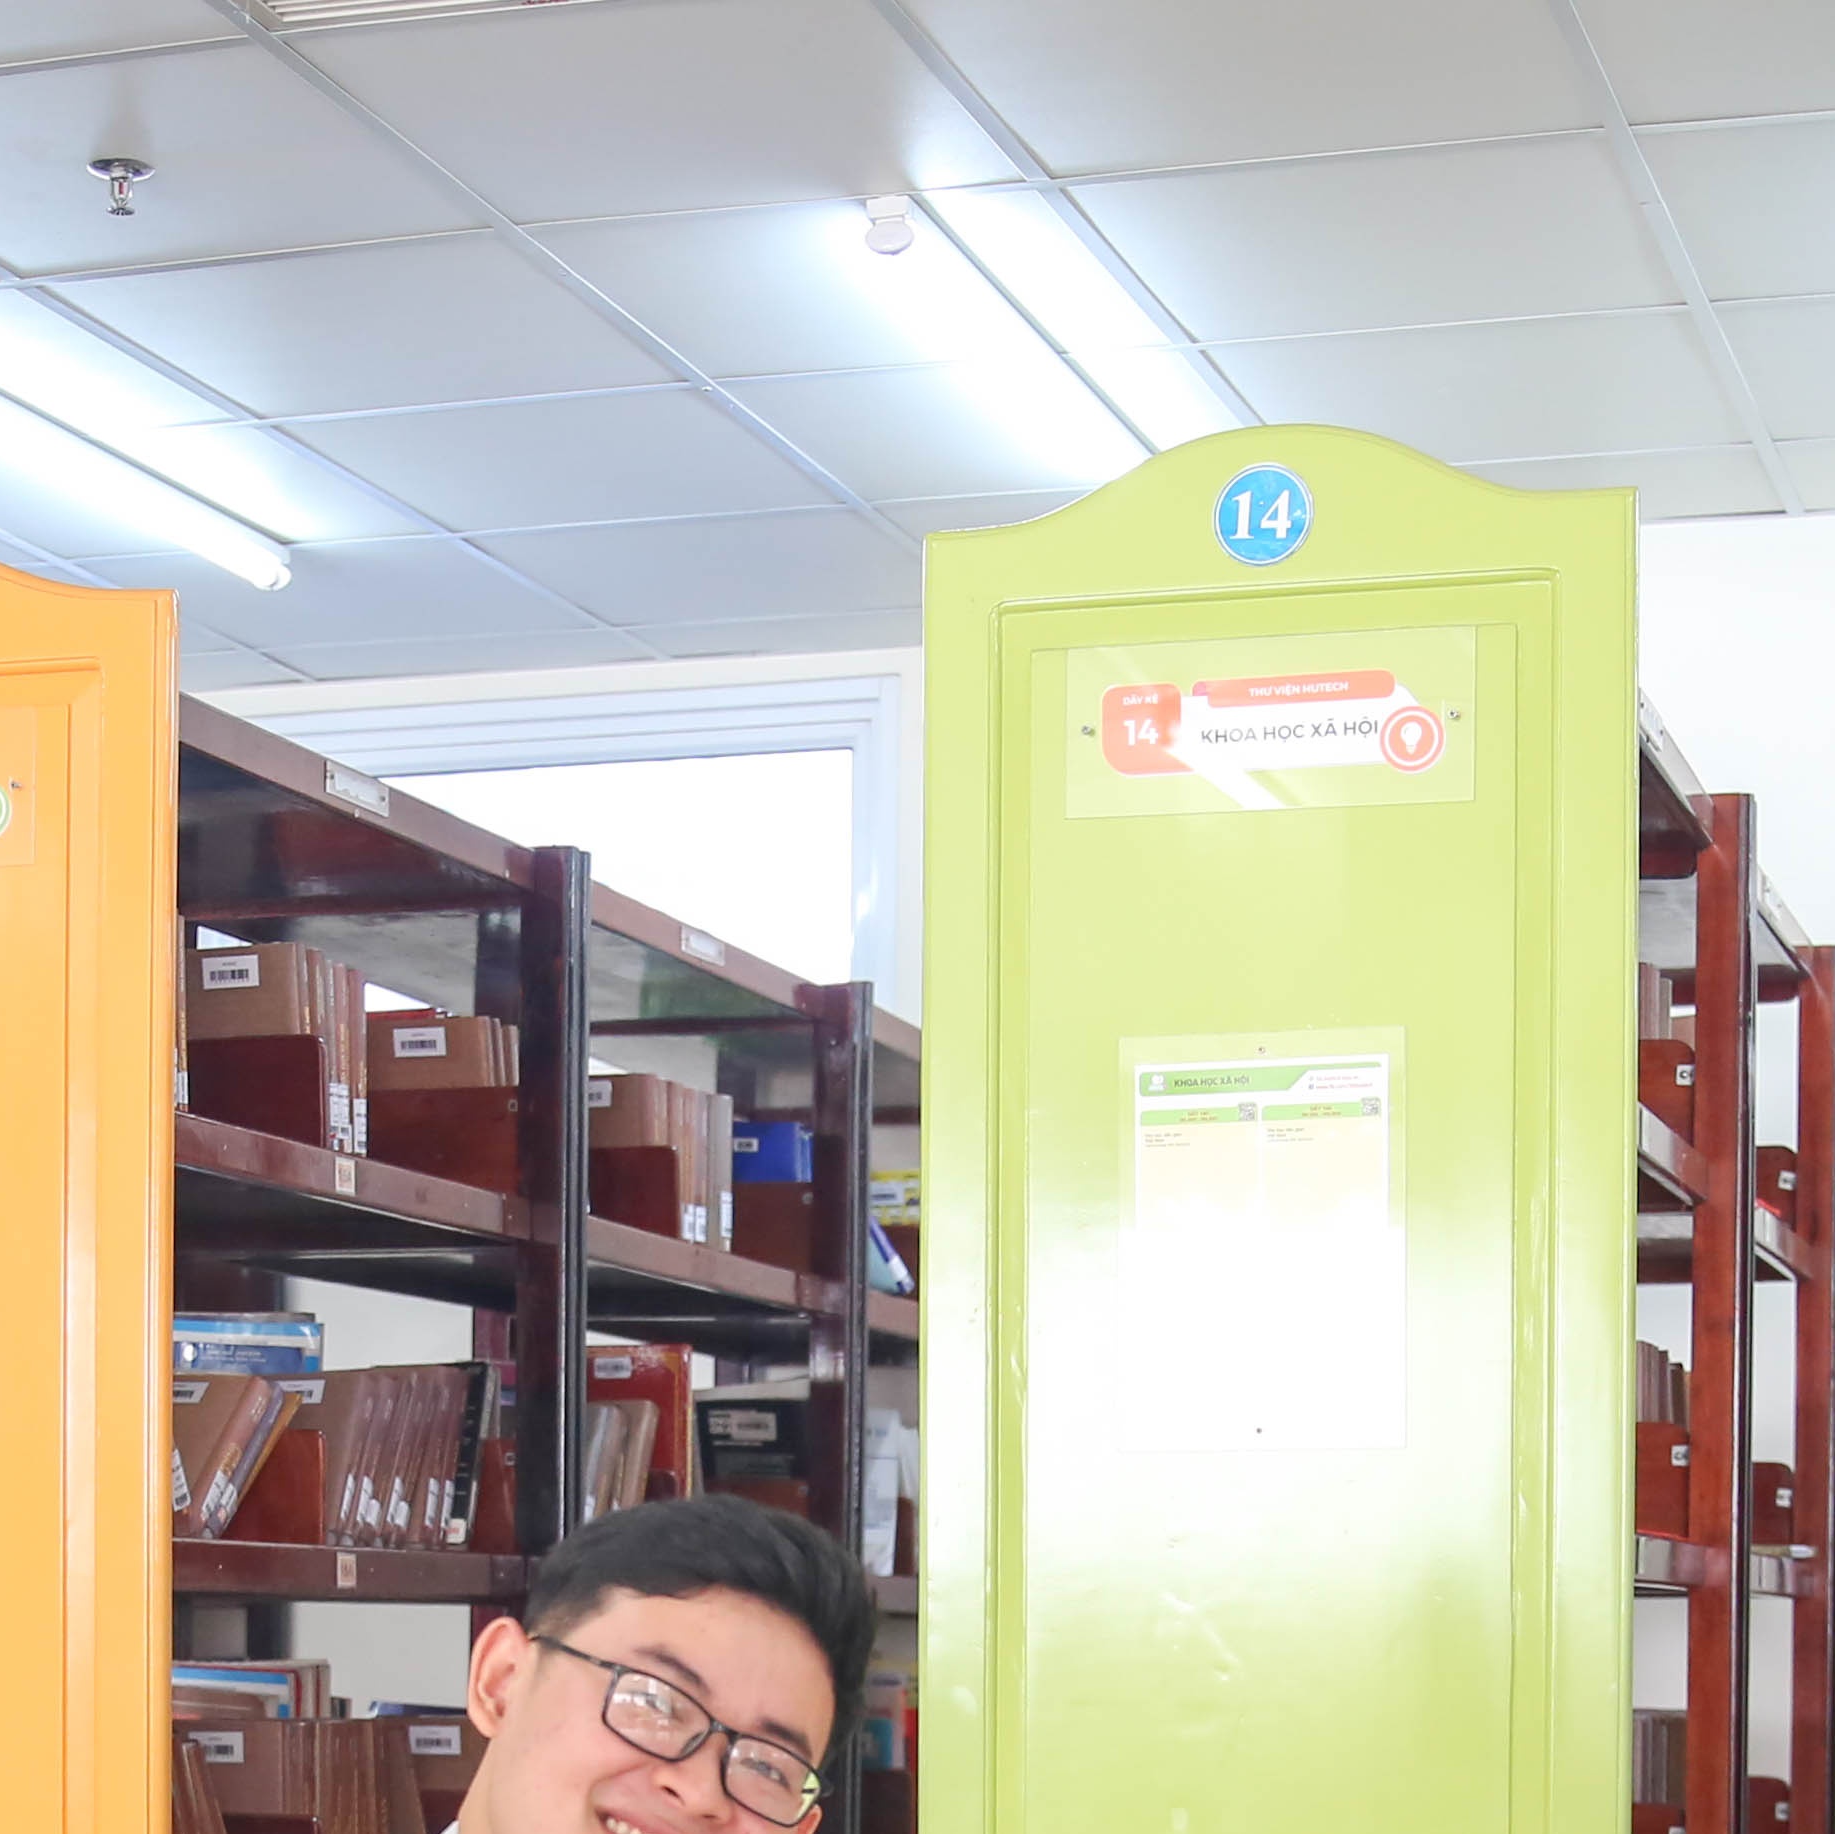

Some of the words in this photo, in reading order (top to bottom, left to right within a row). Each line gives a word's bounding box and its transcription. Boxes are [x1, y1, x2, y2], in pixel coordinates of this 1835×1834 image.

[1228, 489, 1293, 541] 14
[1273, 683, 1301, 698] VIỆN
[1302, 681, 1349, 695] HUTECH
[1123, 719, 1159, 746] 14
[1201, 728, 1257, 744] KHOA
[1263, 724, 1305, 744] HỌC
[1310, 718, 1337, 738] XÃ
[1343, 716, 1379, 737] HỘI
[1174, 1078, 1199, 1088] KHOA
[1200, 1077, 1217, 1088] HỌC
